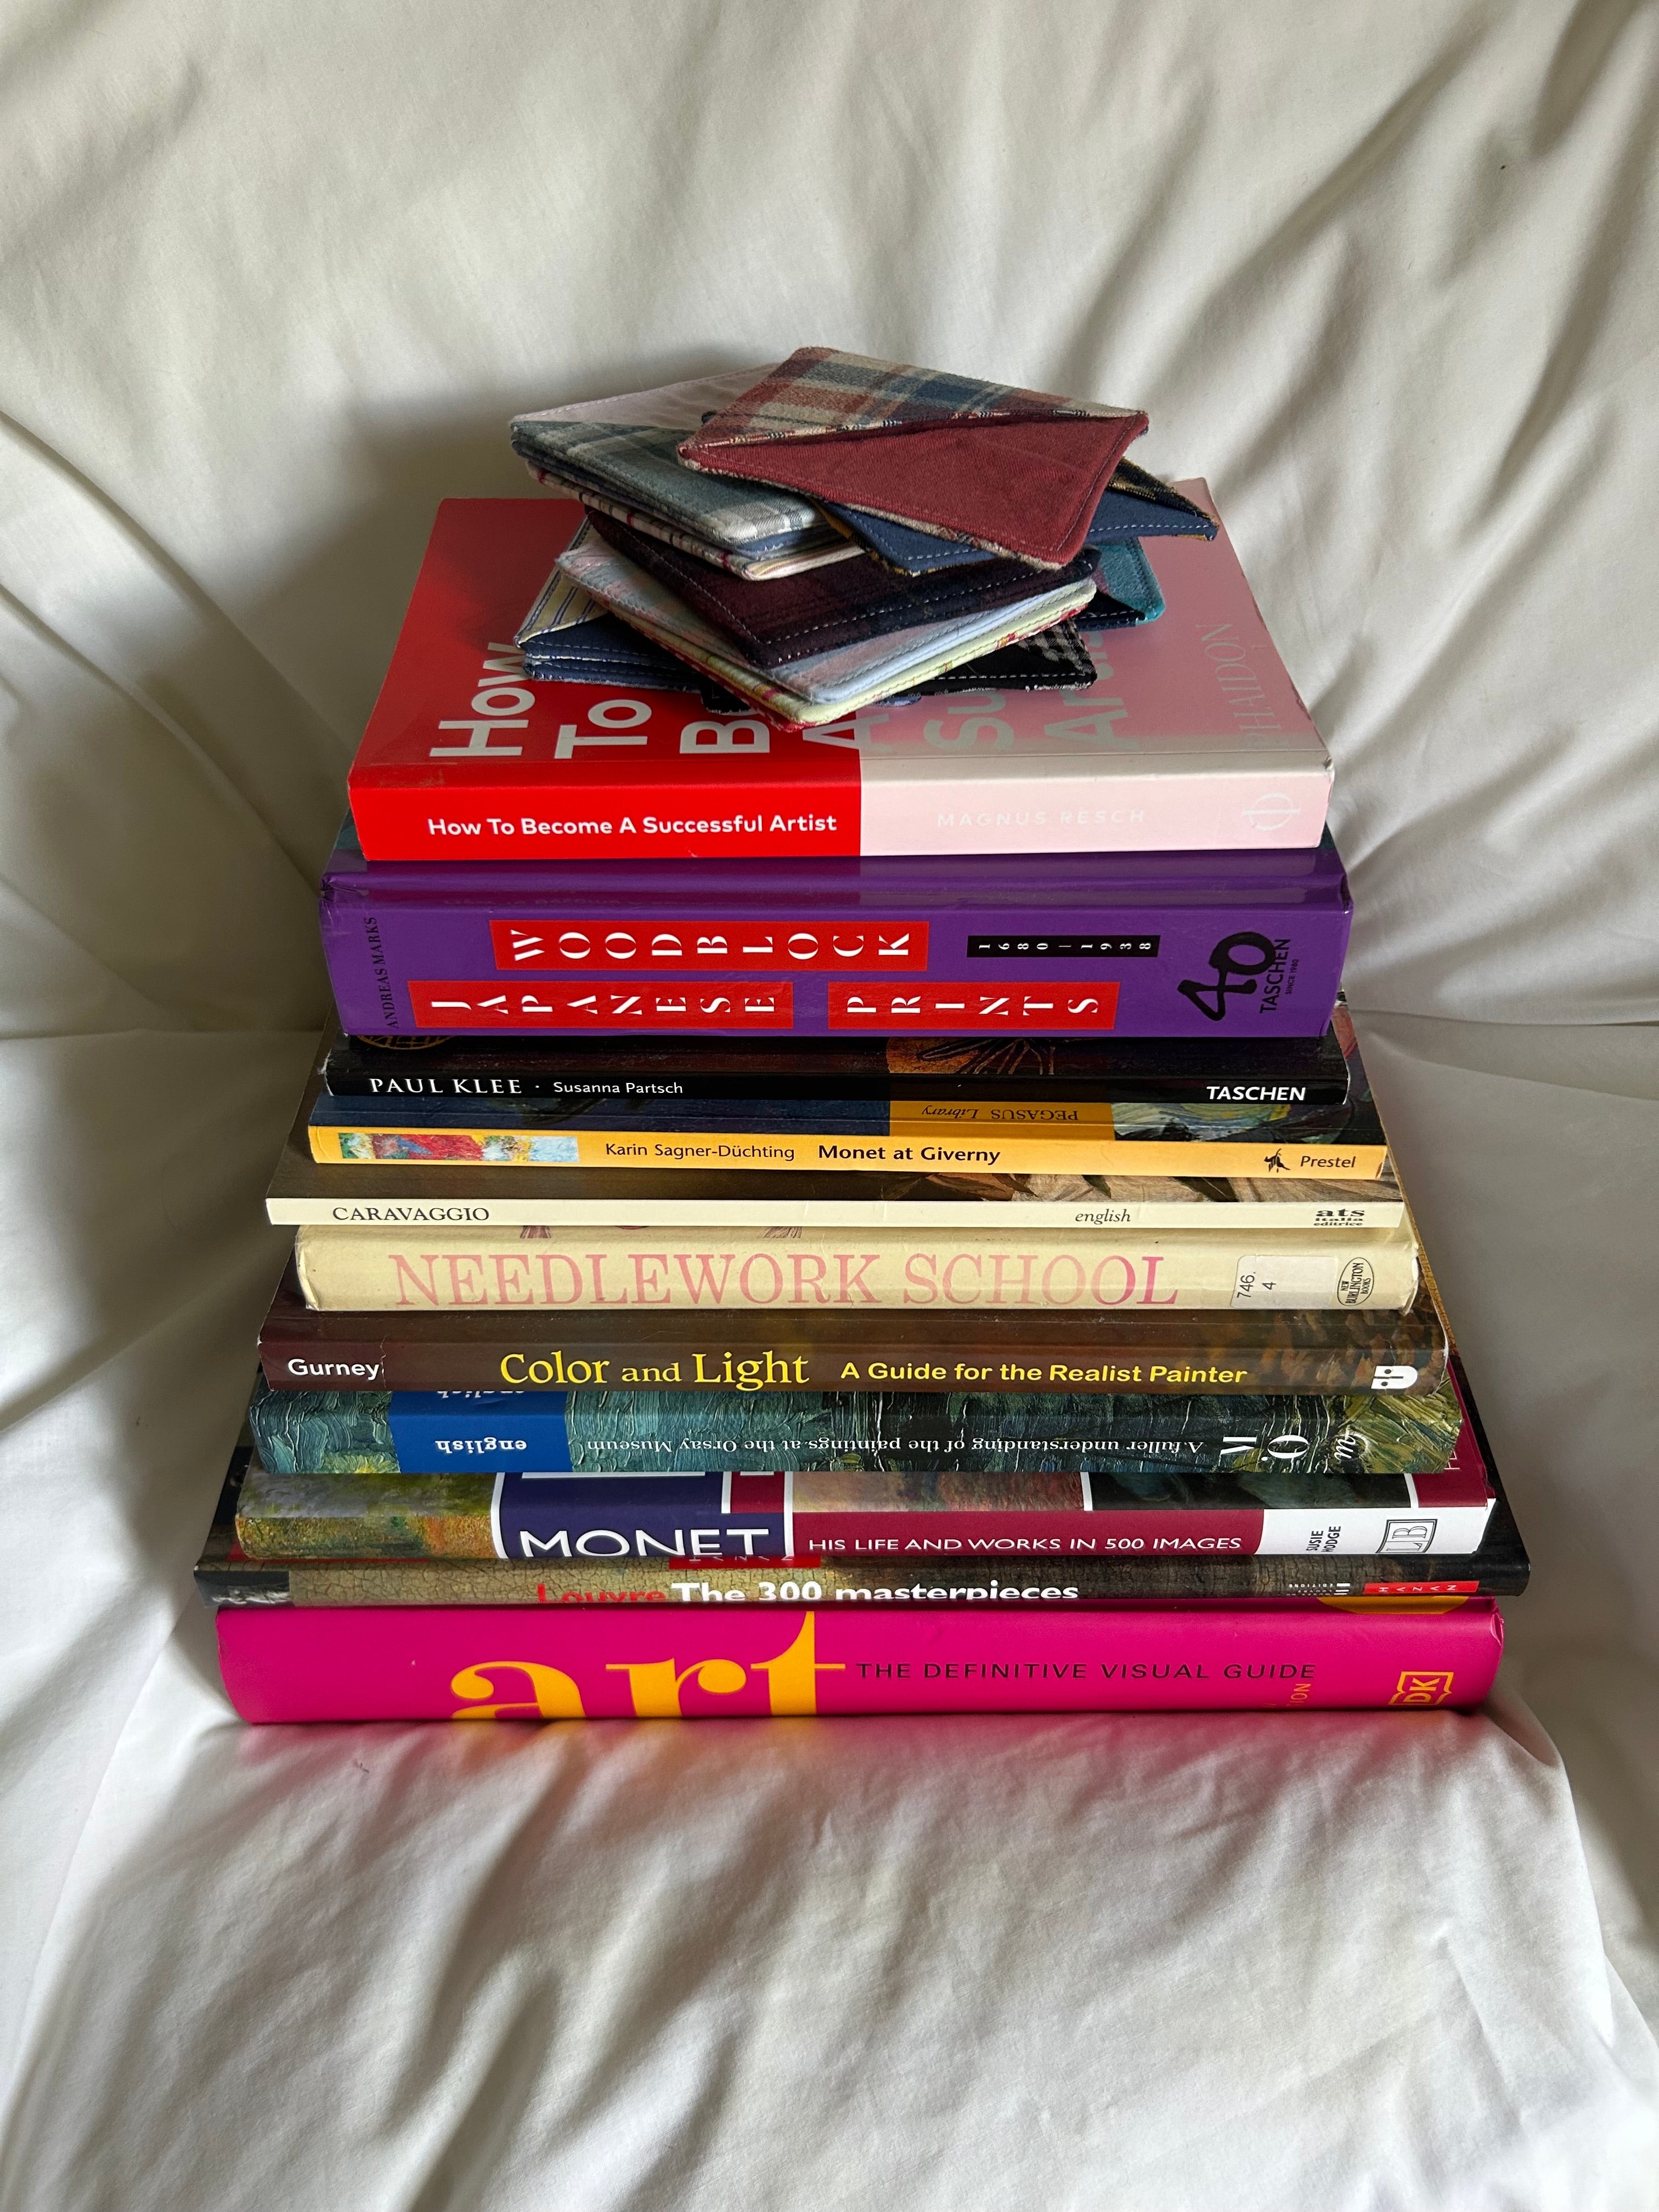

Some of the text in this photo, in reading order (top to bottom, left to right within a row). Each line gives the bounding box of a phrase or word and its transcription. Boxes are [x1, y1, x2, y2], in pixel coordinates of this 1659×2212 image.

[429, 642, 535, 757] How
[554, 699, 652, 759] To
[428, 814, 837, 836] How To Become A Successful Artist
[937, 809, 1145, 827] MAGNUS RESCH
[510, 929, 910, 961] WOODBLOCK
[364, 917, 399, 1029] ANDREAS MARKS
[1177, 931, 1276, 1022] 40
[1260, 939, 1291, 1014] TASCHEN
[1285, 959, 1299, 995] SINCE 1980
[431, 995, 775, 1016] JAPANESE
[847, 996, 1099, 1017] PRINTS
[370, 1078, 684, 1094] PAUL KLEE Susanna Partsch
[1206, 1086, 1306, 1101] TASCHEN
[922, 1104, 1079, 1121] PEGASUS Library
[606, 1143, 1001, 1165] Karin Sagner-Düchting Monet at Giverny
[1300, 1155, 1356, 1169] Prestel
[332, 1206, 489, 1222] CARAVAGGIO
[1075, 1209, 1131, 1224] english
[1316, 1208, 1365, 1217] ats
[388, 1254, 1178, 1306] NEEDLEWORK SCHOOL
[1236, 1271, 1256, 1299] 746.
[1261, 1281, 1277, 1290] 4
[1340, 1280, 1350, 1291] NEW
[1345, 1262, 1364, 1304] BURLINGTON
[1360, 1278, 1371, 1295] BOOKS
[287, 1350, 1248, 1392] Gurney Color and Light A Guide for the Realist Painter
[435, 1436, 527, 1454] english
[588, 1437, 1204, 1453] A fuller understanding of the paintings at the Orsay Museum
[520, 1528, 1242, 1558] MONET HIS LIFE AND WORKS IN 500 IMAGES
[1305, 1530, 1324, 1551] SUSIE
[1321, 1526, 1341, 1552] HODGE
[537, 1579, 1079, 1603] Louvre The 300 masterpieces
[450, 1611, 845, 1719] art
[855, 1663, 1316, 1679] THE DEFINITIVE VISUAL GUIDE
[1402, 1677, 1441, 1703] DK
